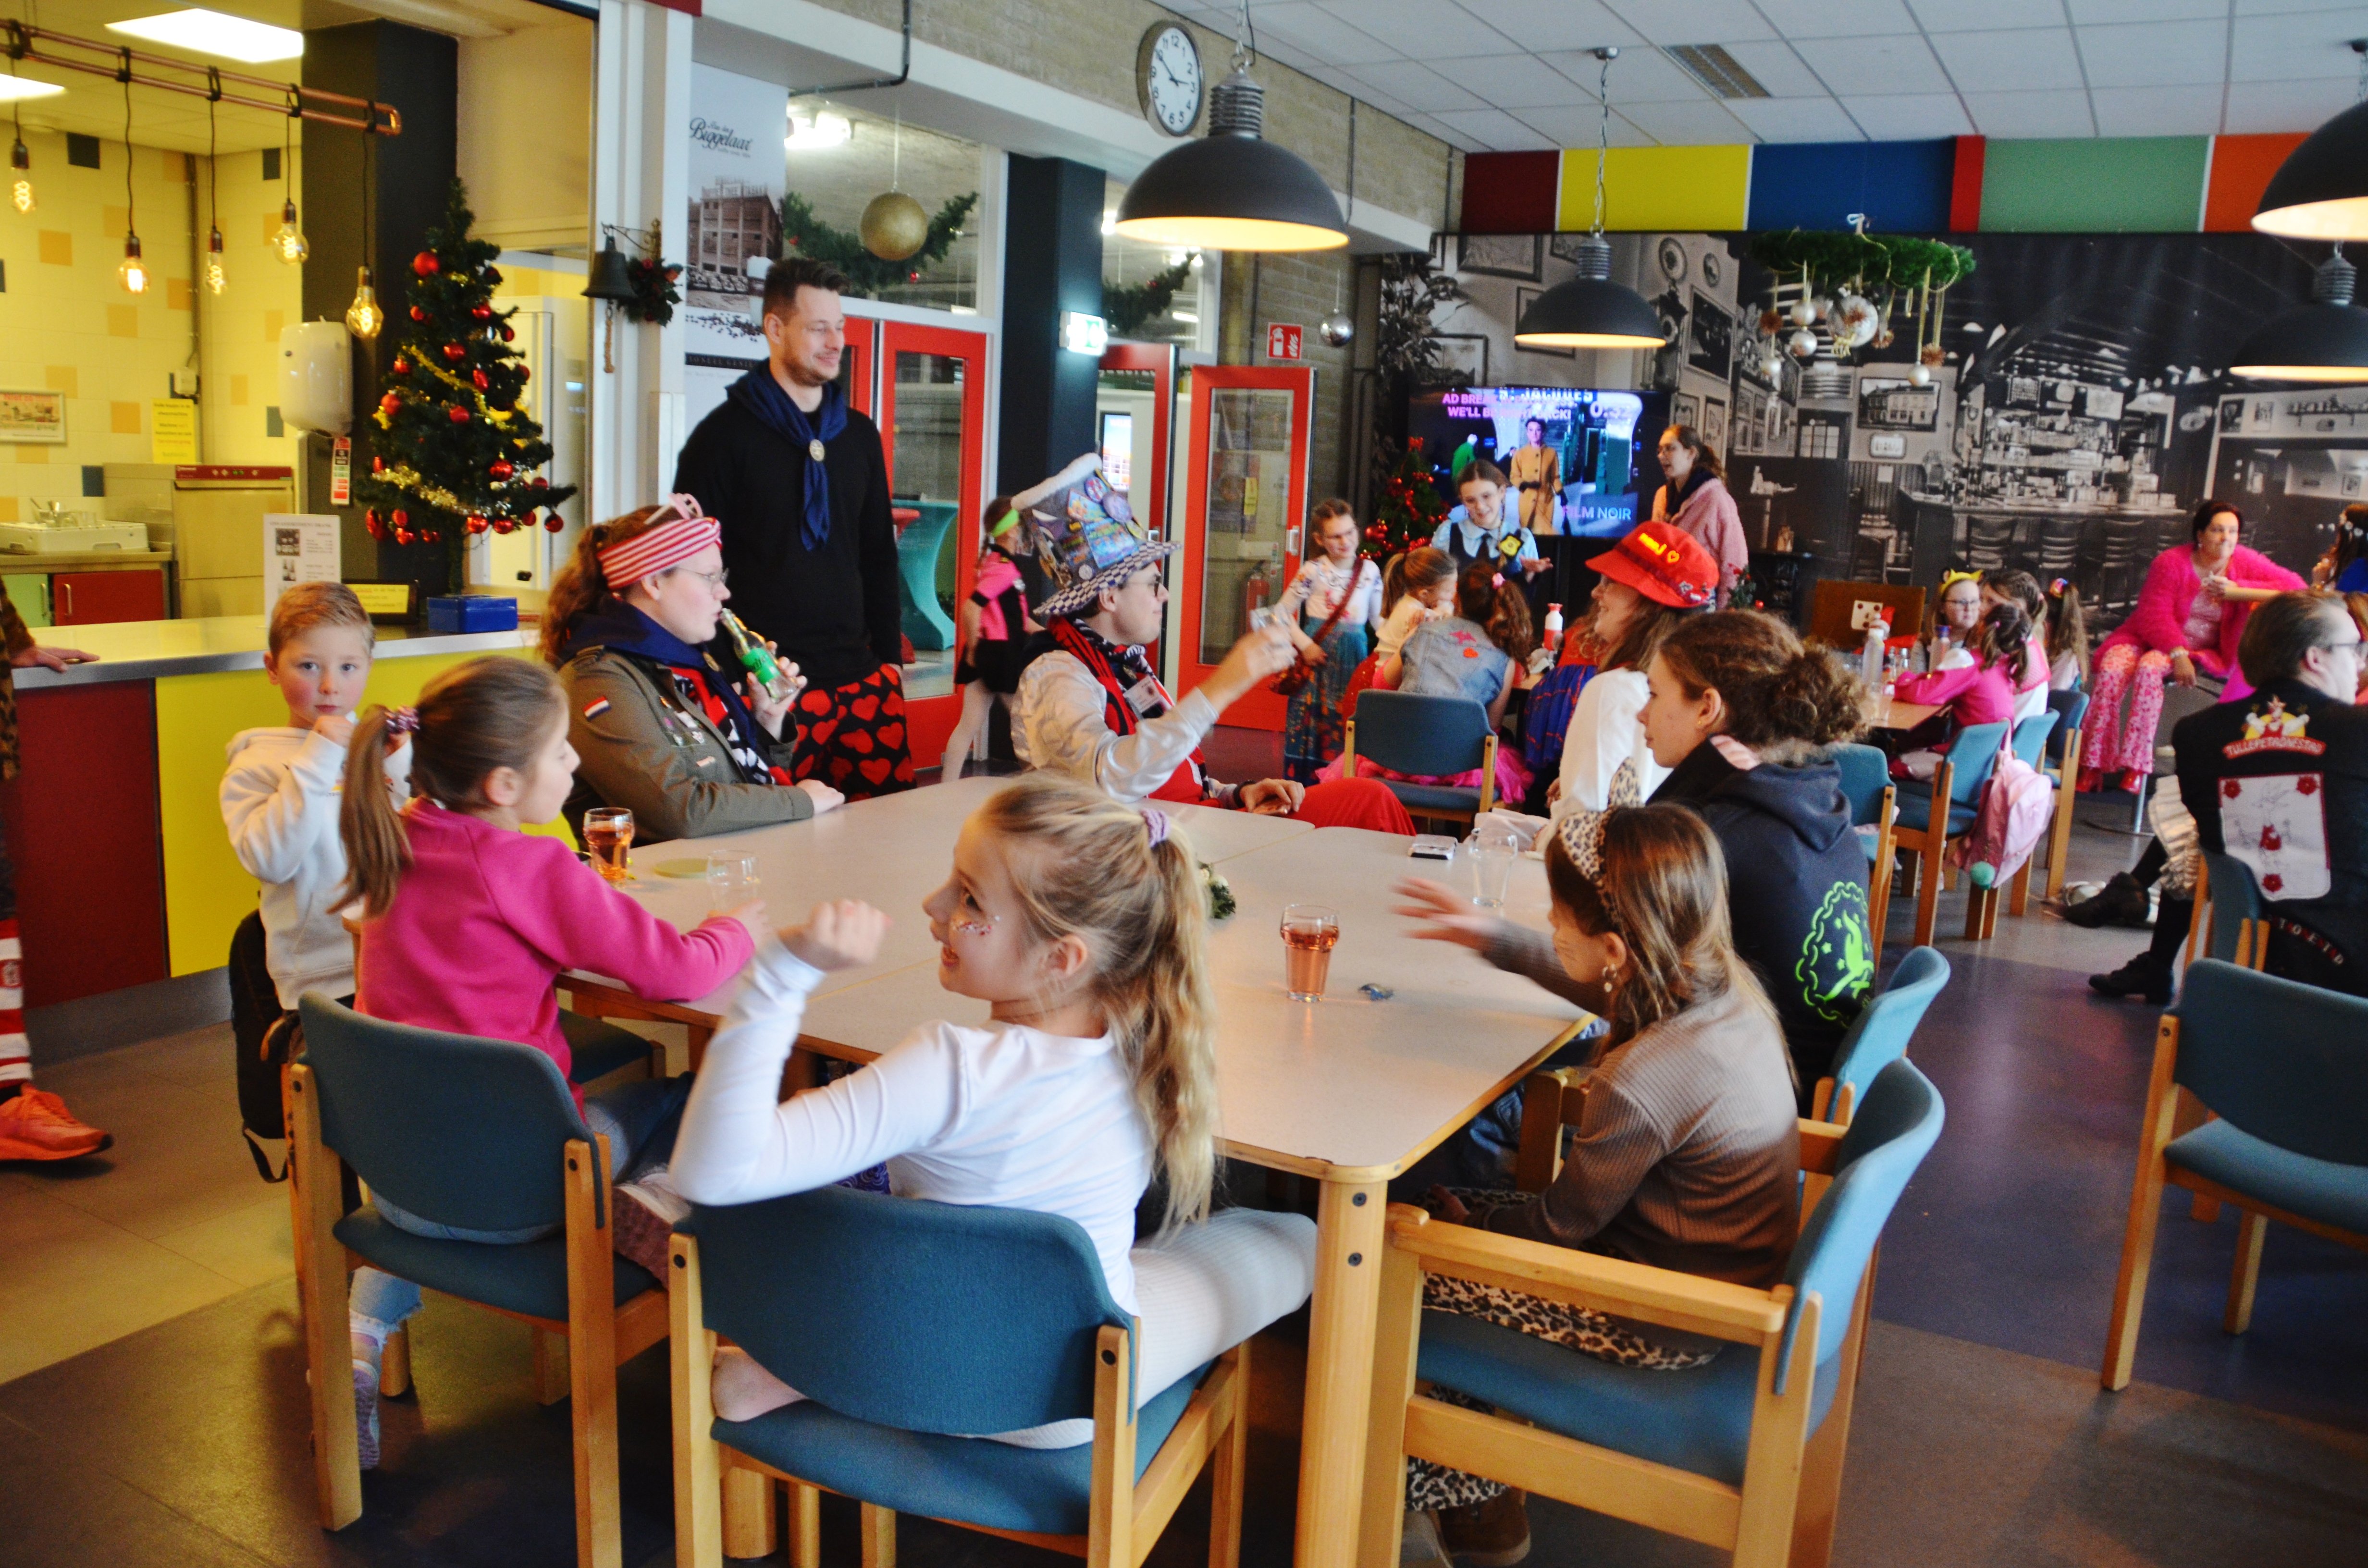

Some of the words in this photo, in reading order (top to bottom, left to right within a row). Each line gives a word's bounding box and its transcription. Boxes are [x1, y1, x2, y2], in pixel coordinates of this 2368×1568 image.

[1171, 35, 1180, 48] 12
[1187, 61, 1193, 74] 2
[1153, 86, 1159, 98] 8
[1190, 81, 1196, 93] 3
[1160, 104, 1166, 116] 7
[1186, 99, 1191, 110] 4
[1169, 112, 1174, 124] 6
[1179, 110, 1184, 123] 5
[1443, 393, 1459, 404] AD
[1447, 406, 1480, 417] WE'LL
[1597, 506, 1631, 520] NOIR
